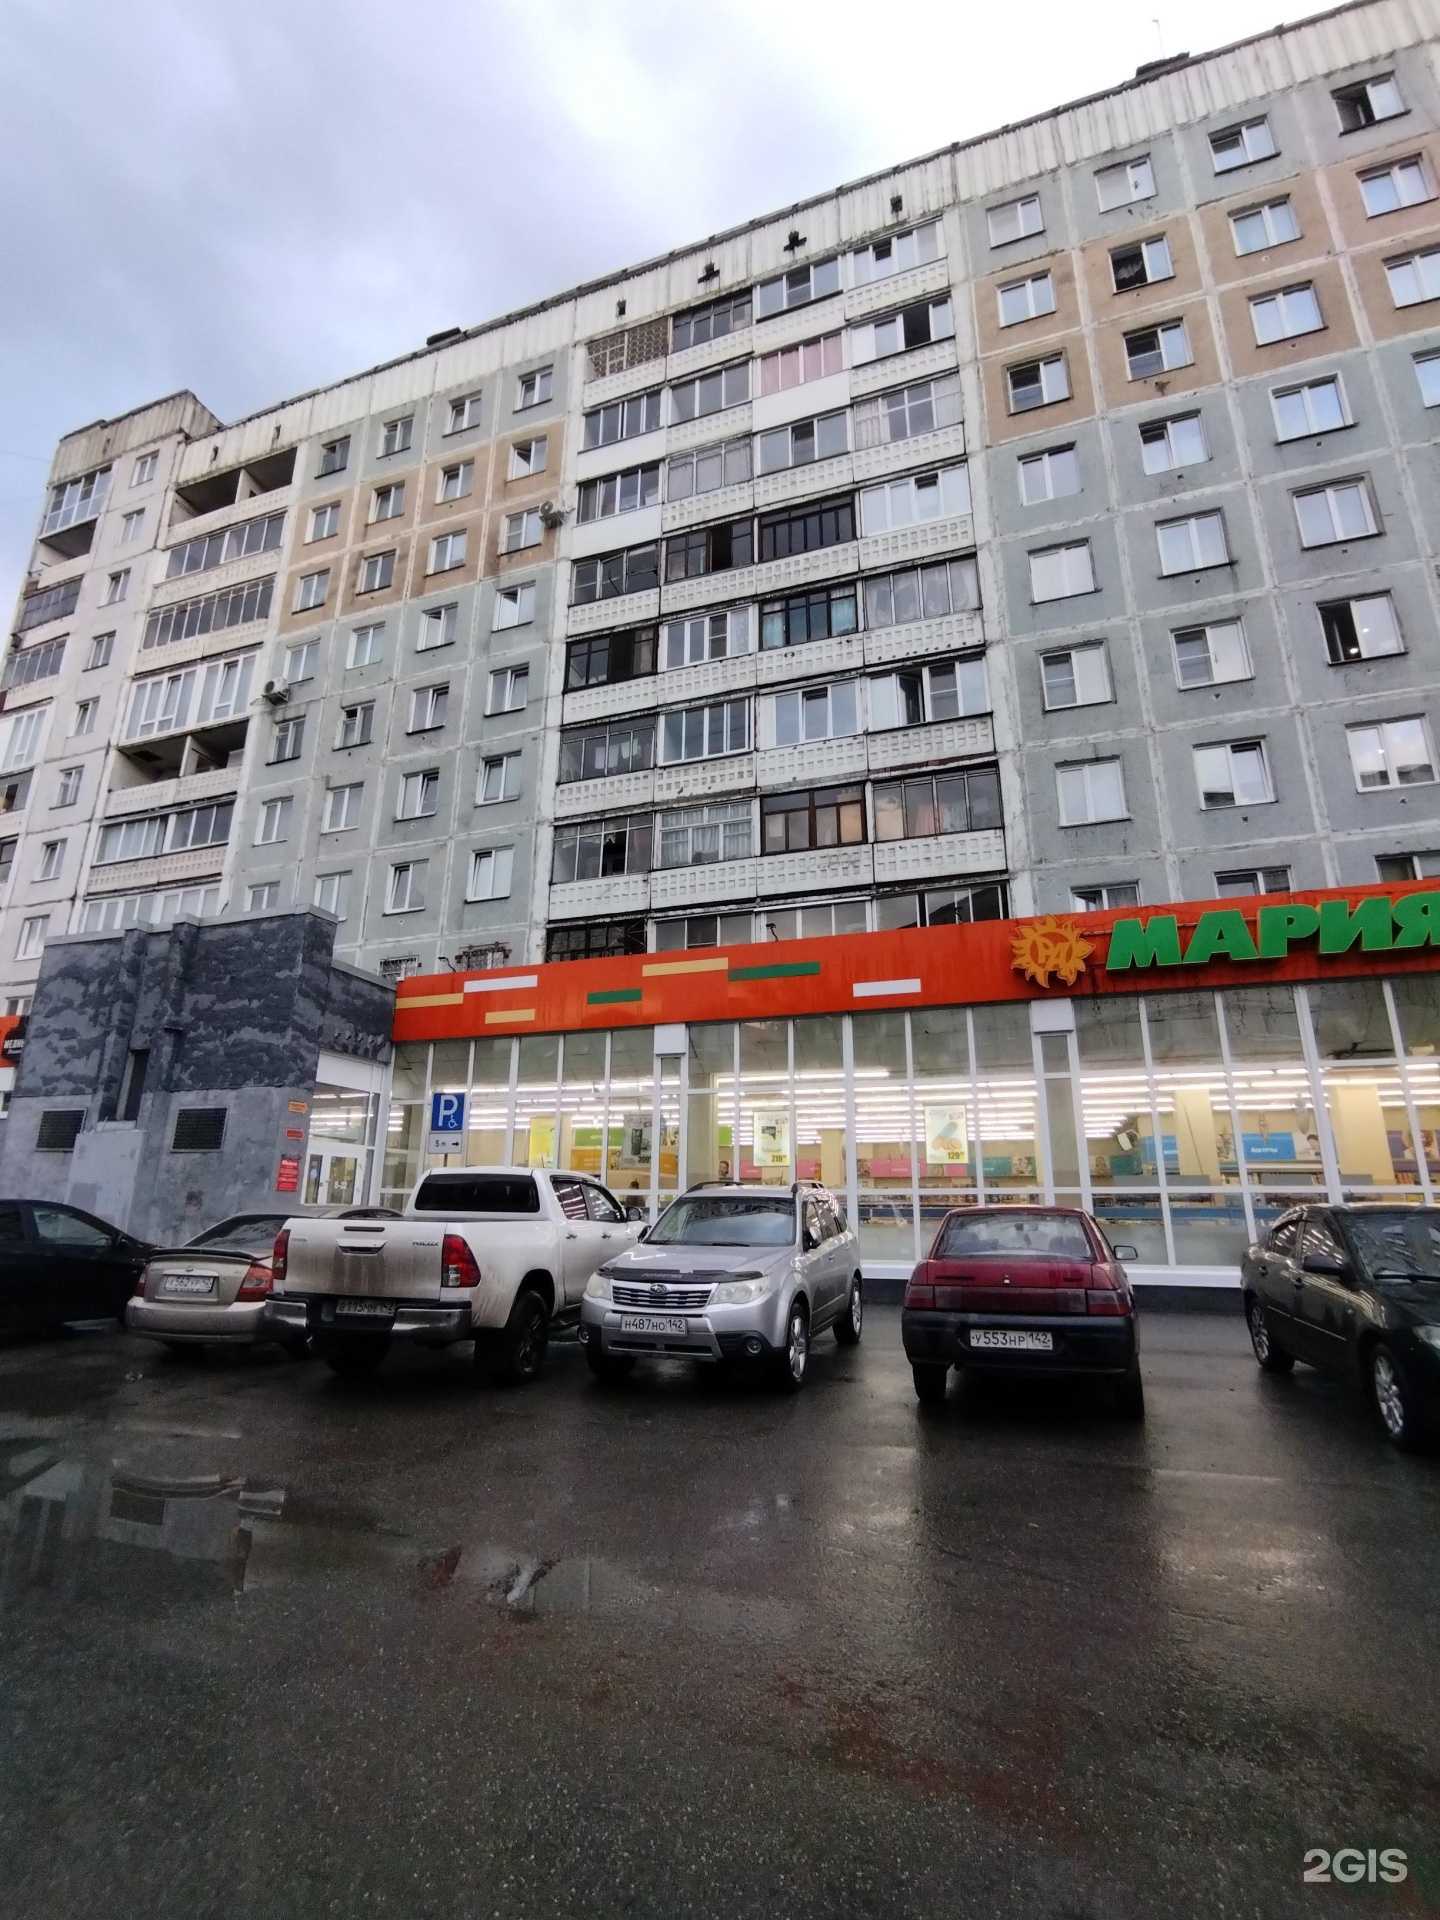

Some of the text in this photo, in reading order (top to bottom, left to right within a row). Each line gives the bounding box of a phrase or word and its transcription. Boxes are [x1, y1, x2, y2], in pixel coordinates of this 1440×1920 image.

[1106, 891, 1440, 970] МАРИЯ
[438, 1095, 458, 1127] P
[624, 1318, 684, 1331] Н487НО 142
[975, 1331, 1048, 1346] У553НР 142
